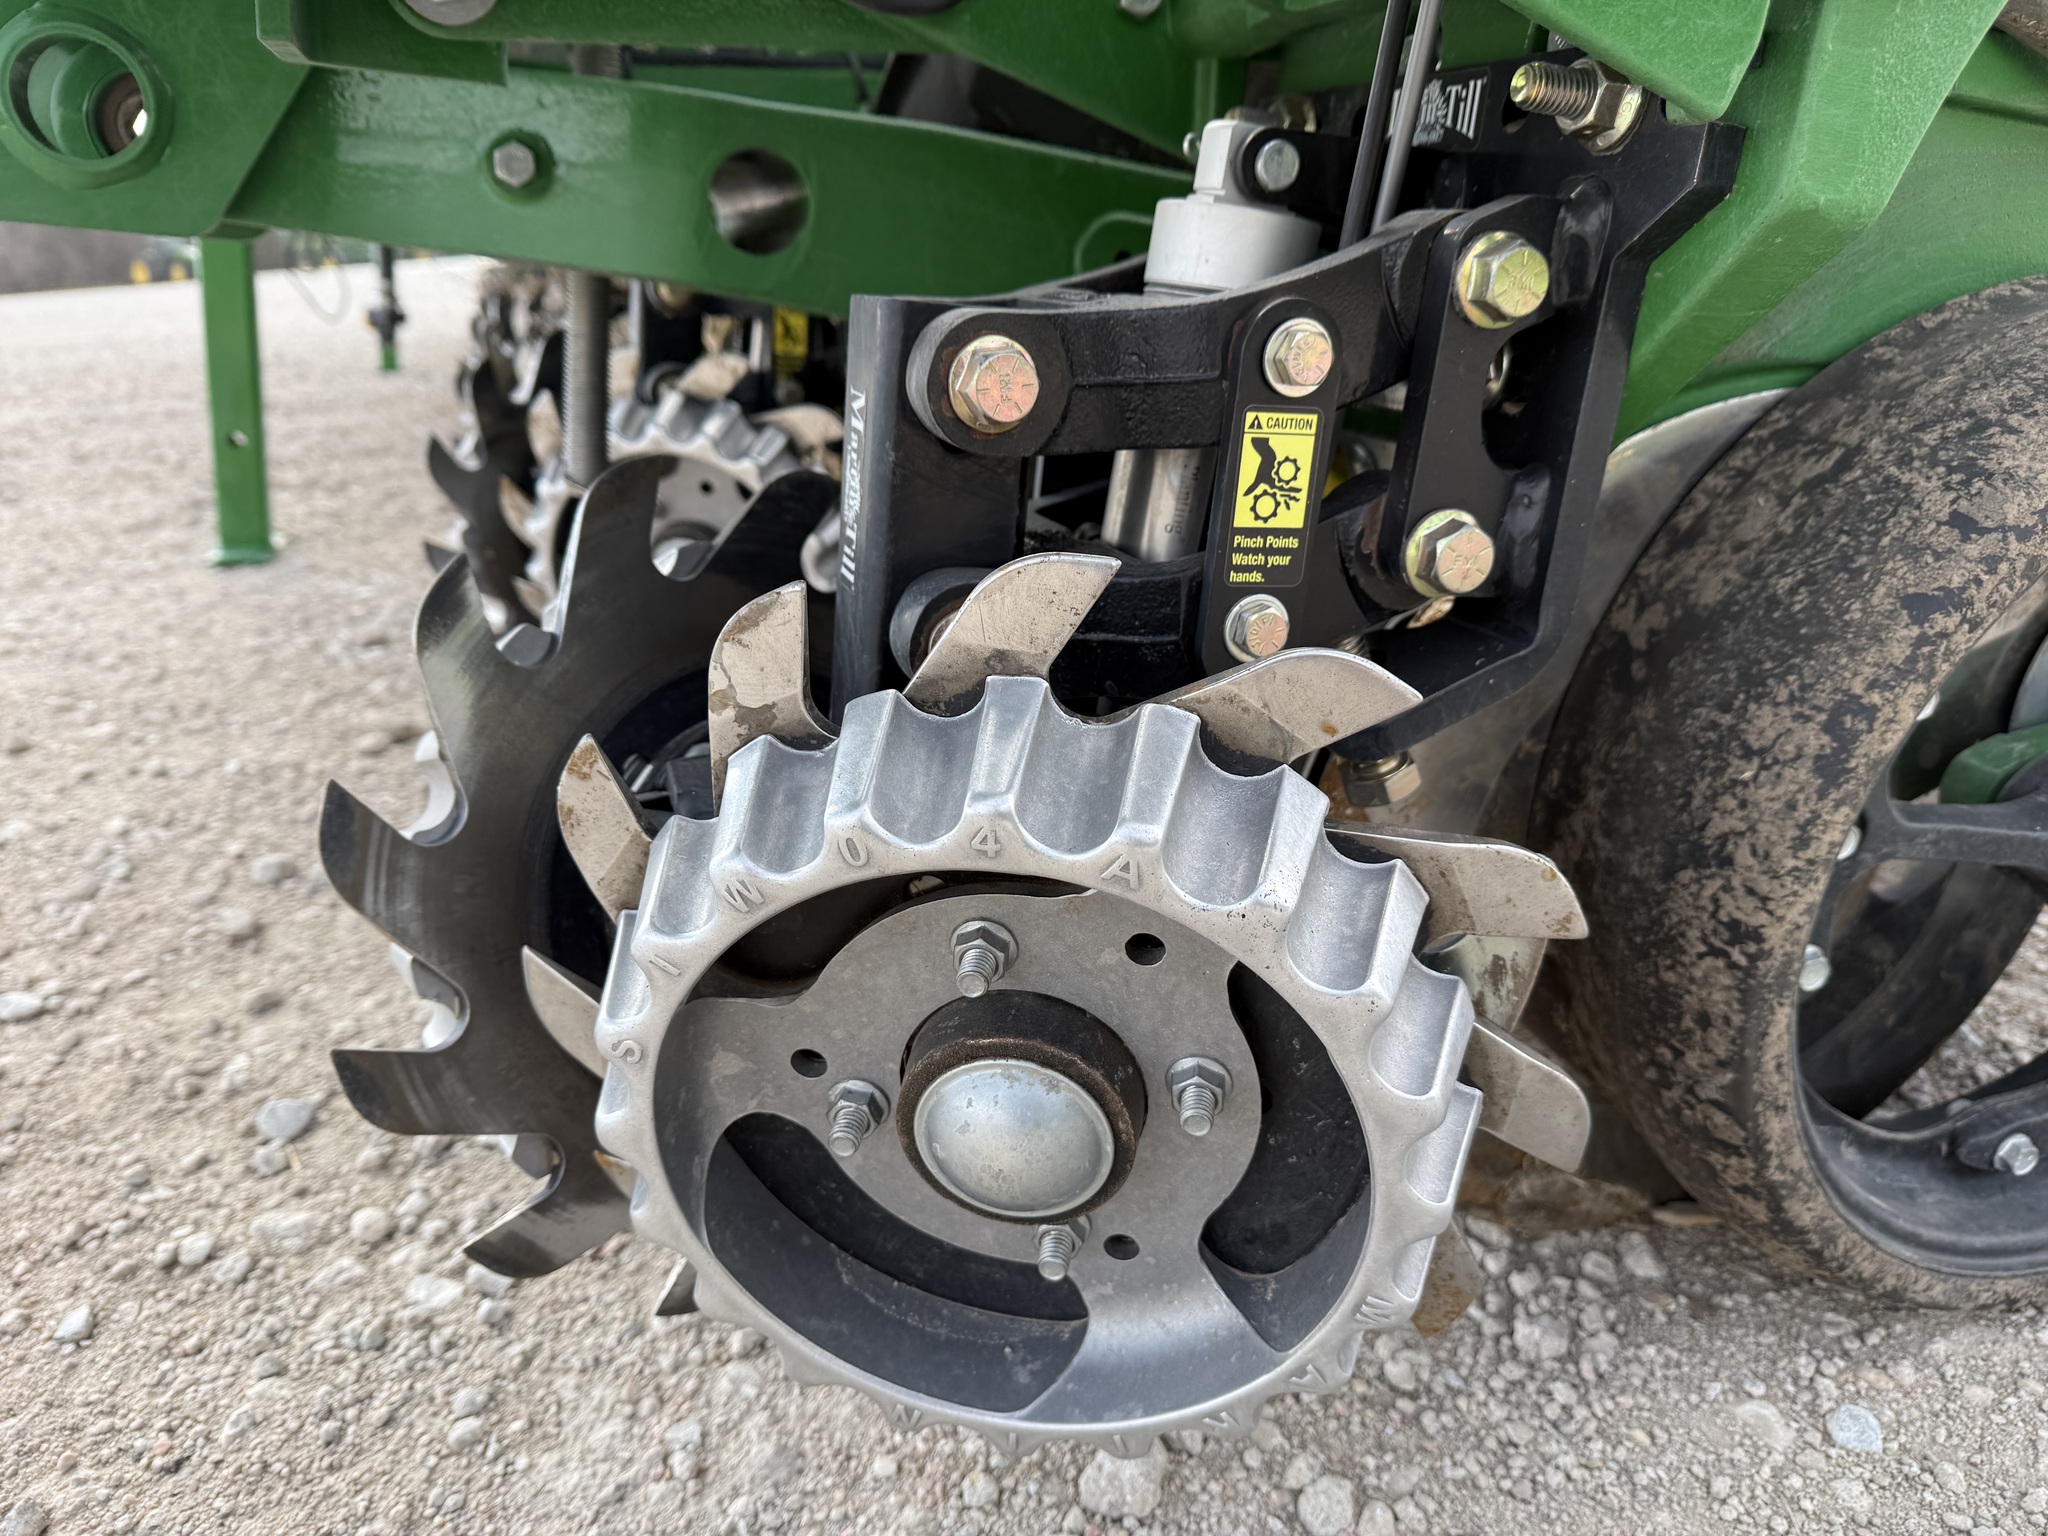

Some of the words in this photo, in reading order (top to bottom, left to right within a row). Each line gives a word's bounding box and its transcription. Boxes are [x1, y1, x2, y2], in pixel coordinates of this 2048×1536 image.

[1266, 416, 1313, 431] CAUTION
[1233, 534, 1264, 548] Pinch
[1265, 535, 1299, 549] Points
[1232, 552, 1265, 566] Watch
[1266, 555, 1292, 568] your
[1229, 570, 1265, 583] hands.
